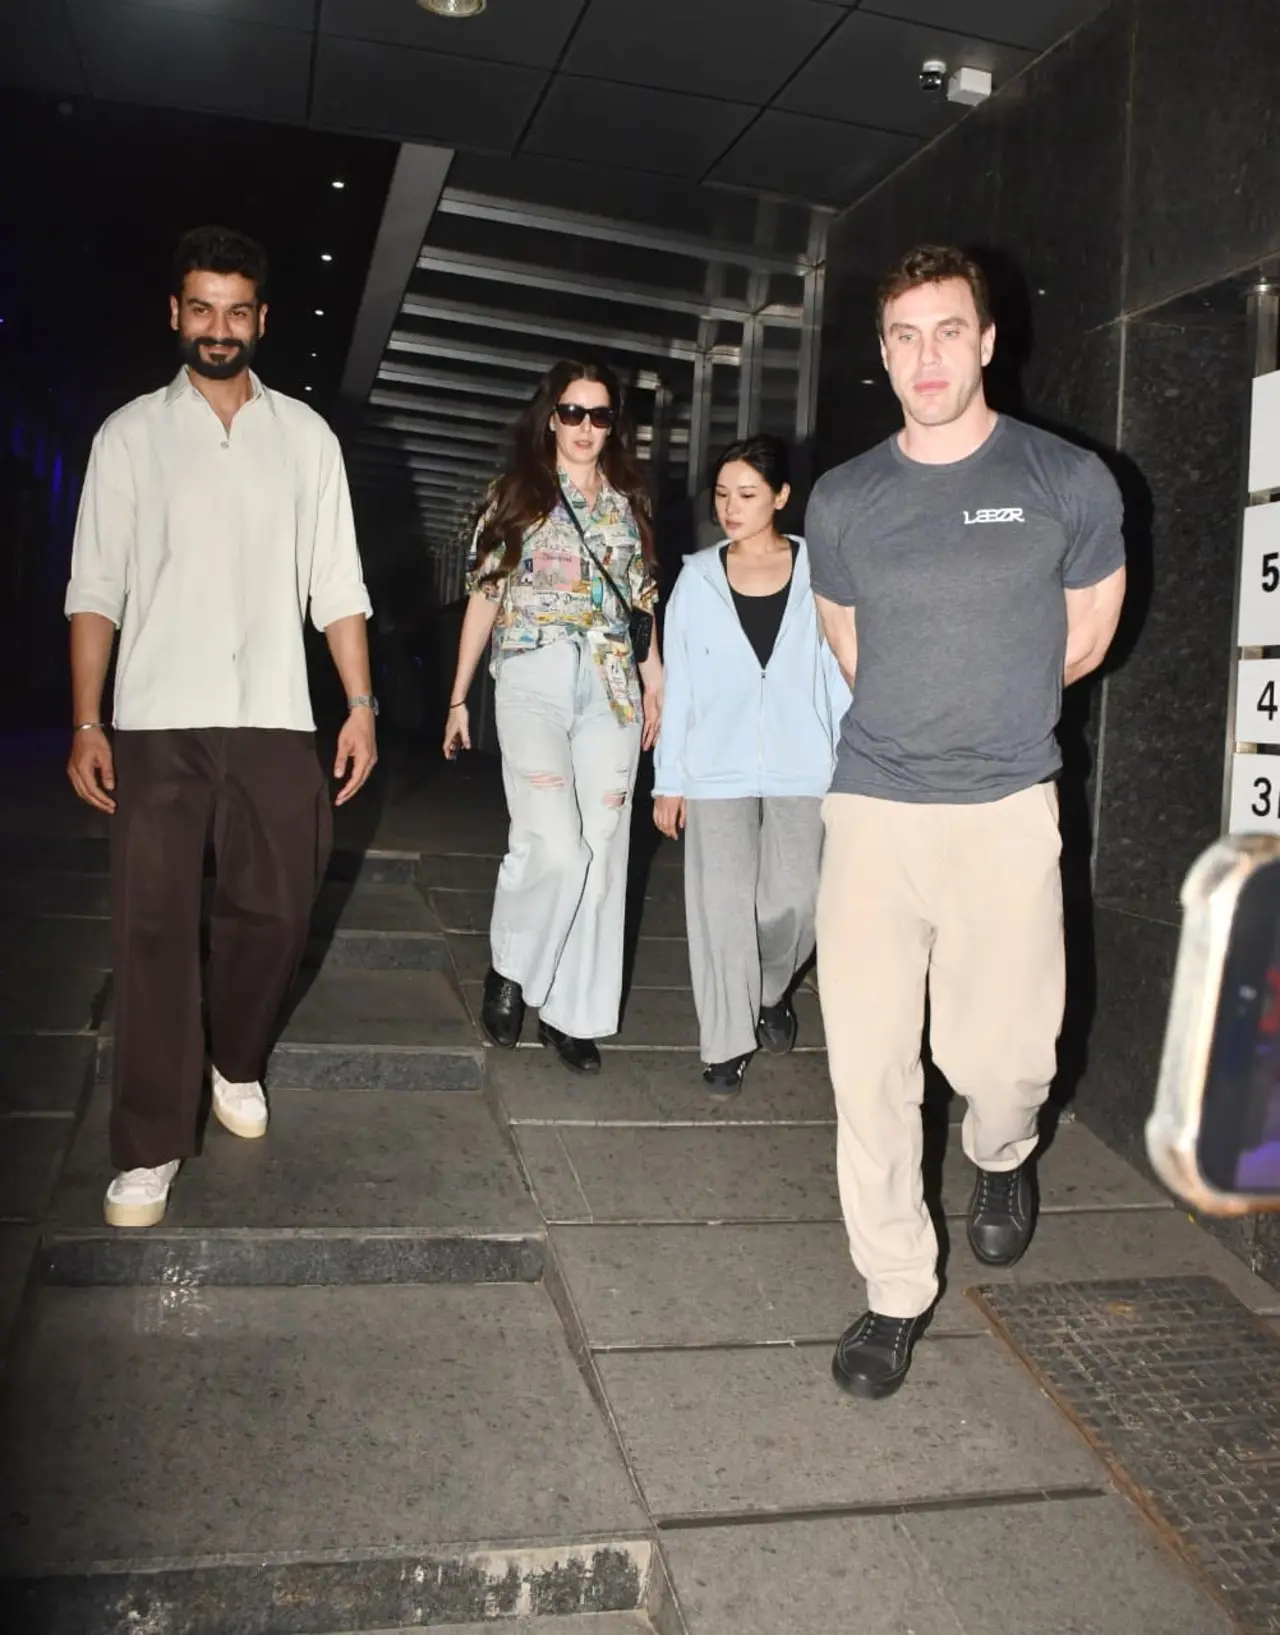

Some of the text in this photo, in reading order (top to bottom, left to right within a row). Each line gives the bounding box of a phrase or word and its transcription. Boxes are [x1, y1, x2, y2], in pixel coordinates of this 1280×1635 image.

[1262, 552, 1279, 593] 5
[1257, 680, 1278, 721] 4
[1251, 777, 1280, 819] 3
